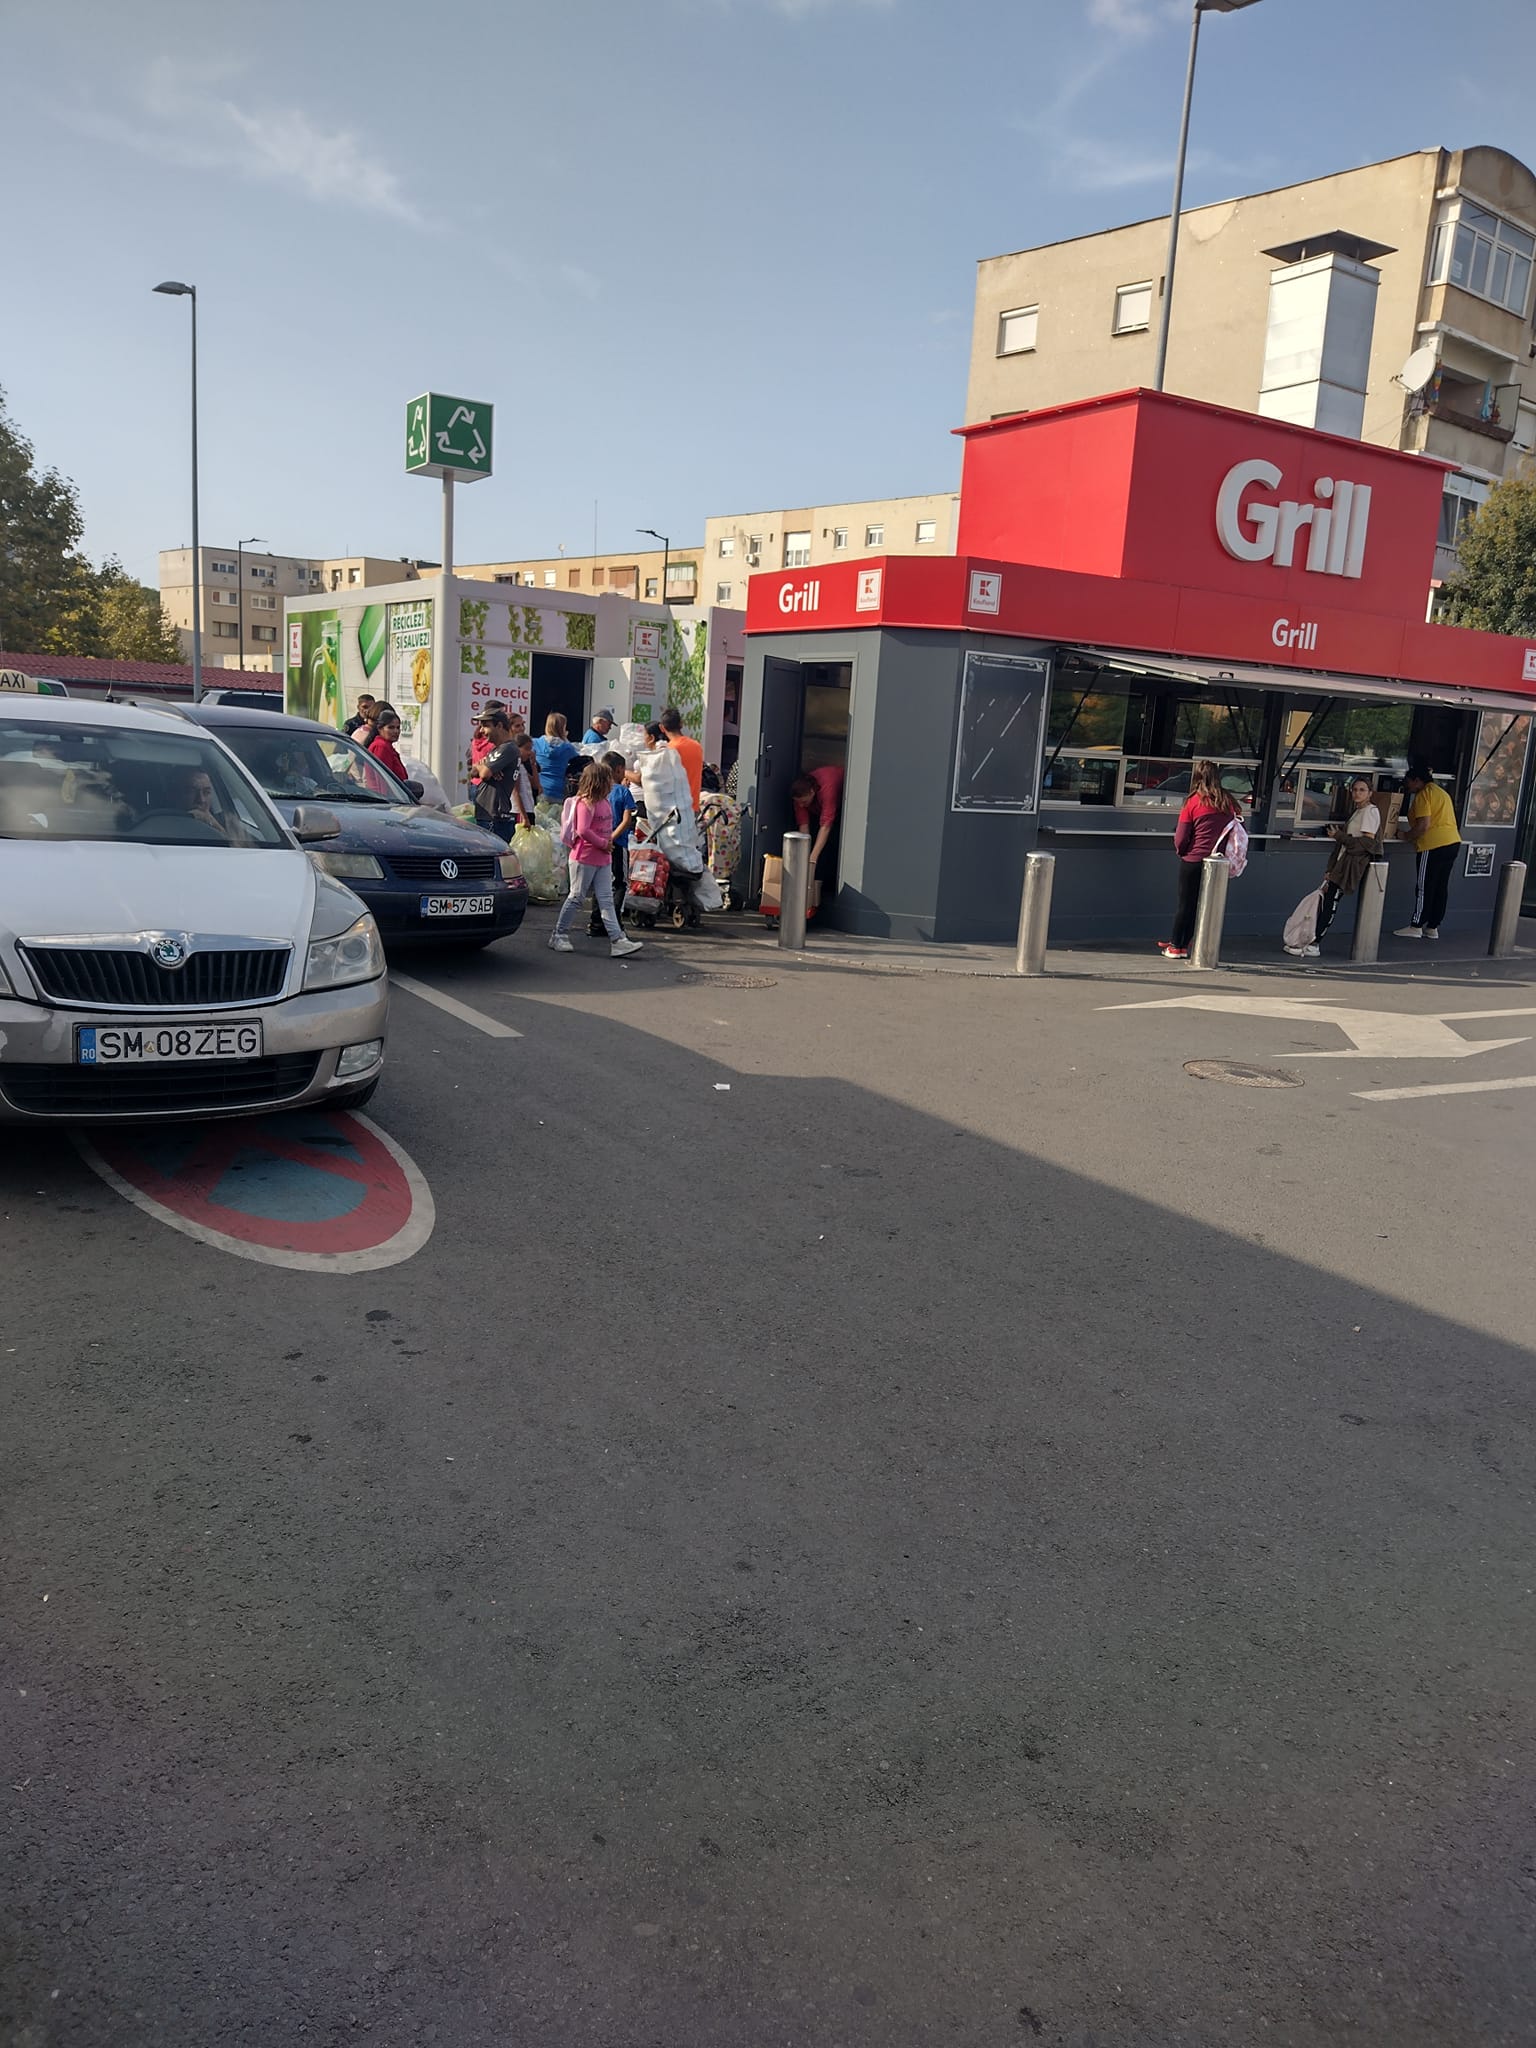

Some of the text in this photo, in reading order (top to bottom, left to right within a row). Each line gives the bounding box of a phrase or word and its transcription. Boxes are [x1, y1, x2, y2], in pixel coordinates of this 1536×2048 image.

[1216, 459, 1372, 579] Grill
[779, 581, 820, 612] Grill
[393, 612, 424, 631] RECICLEZI
[404, 632, 430, 648] SALVEZI
[1272, 618, 1318, 650] Grill
[0, 672, 25, 688] AXI
[472, 681, 491, 696] Să
[471, 701, 480, 711] e
[429, 900, 447, 914] SM
[453, 899, 467, 912] 57
[470, 898, 493, 912] SAB
[100, 1032, 143, 1059] SM
[82, 1048, 95, 1060] RO
